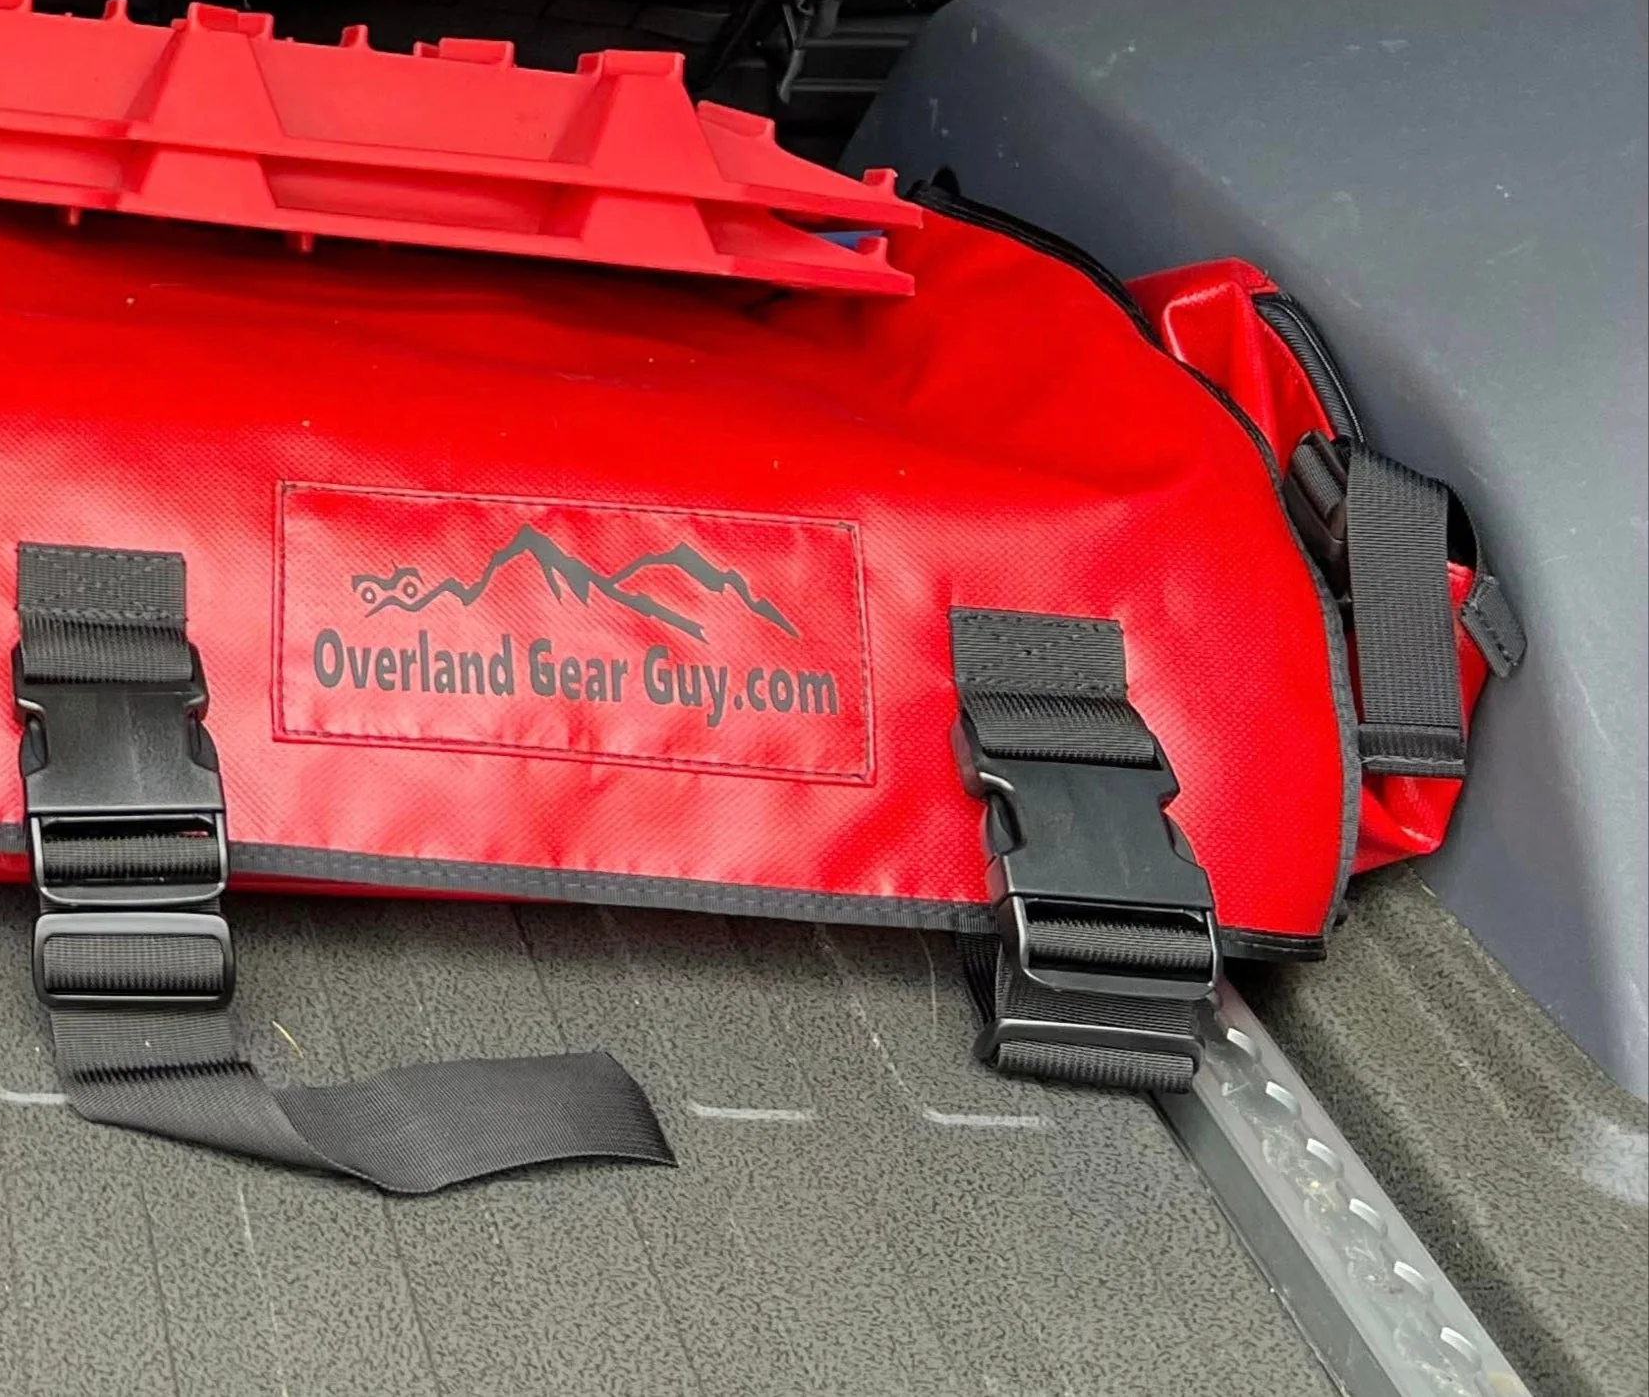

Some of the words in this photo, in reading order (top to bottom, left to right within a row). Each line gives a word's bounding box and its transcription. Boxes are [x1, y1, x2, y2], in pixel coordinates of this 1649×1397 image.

[313, 628, 514, 698] Overland
[528, 637, 628, 703] Gear
[643, 645, 838, 727] Guy.com
